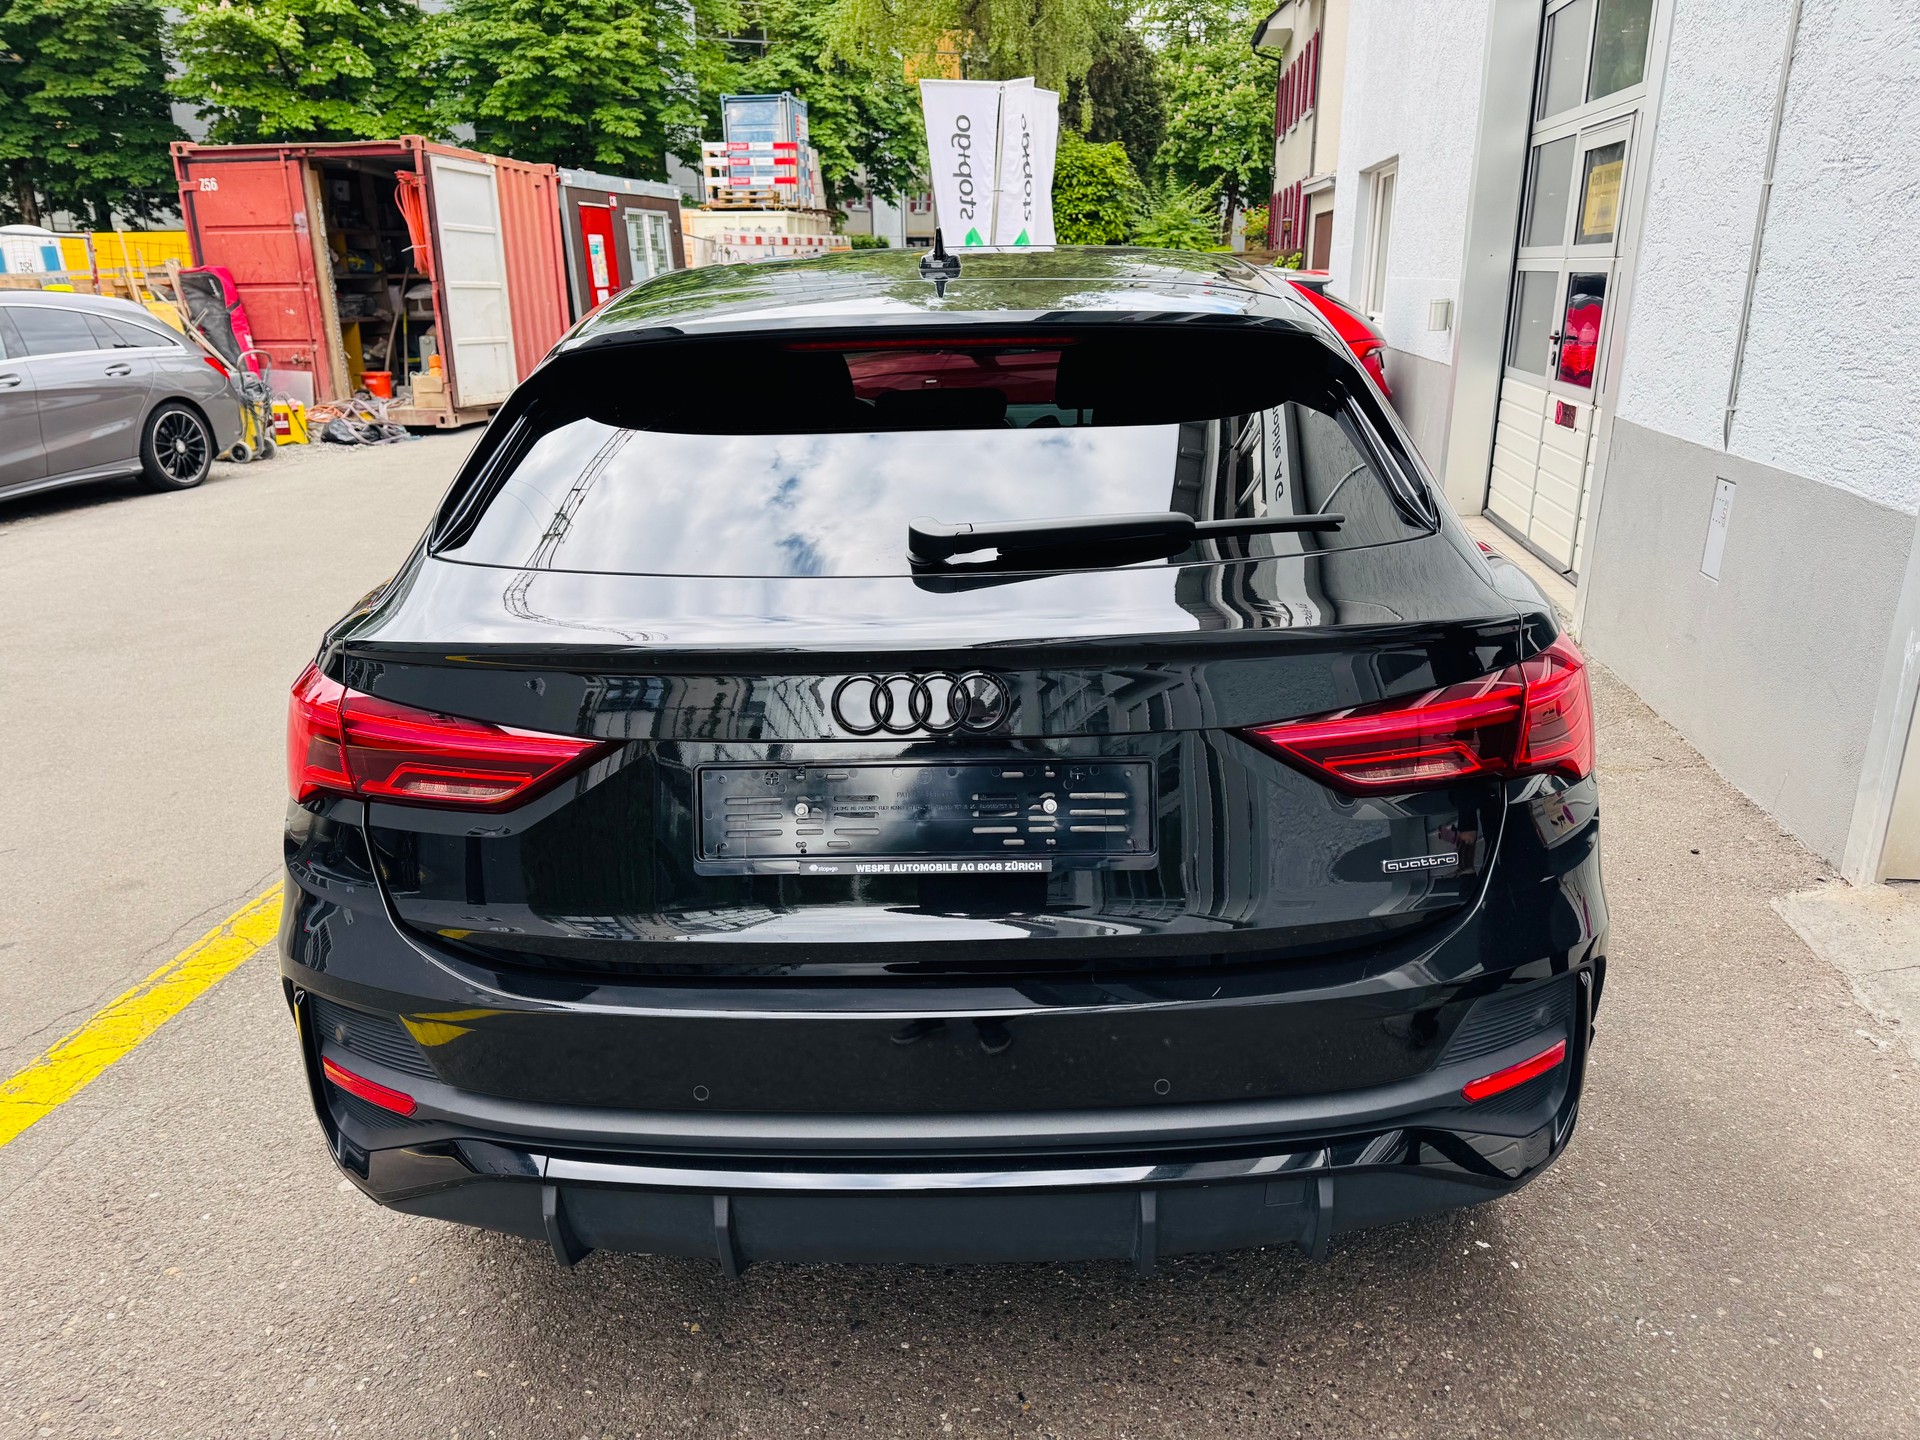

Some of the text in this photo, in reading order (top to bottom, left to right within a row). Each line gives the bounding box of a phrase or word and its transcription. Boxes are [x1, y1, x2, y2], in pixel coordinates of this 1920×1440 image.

[855, 864, 891, 872] WESPE
[893, 863, 958, 872] AUTOMOBILE
[960, 863, 975, 871] AG
[977, 863, 1003, 871] 8048
[1004, 861, 1043, 871] ZÜRICH
[1387, 856, 1456, 871] quattro
